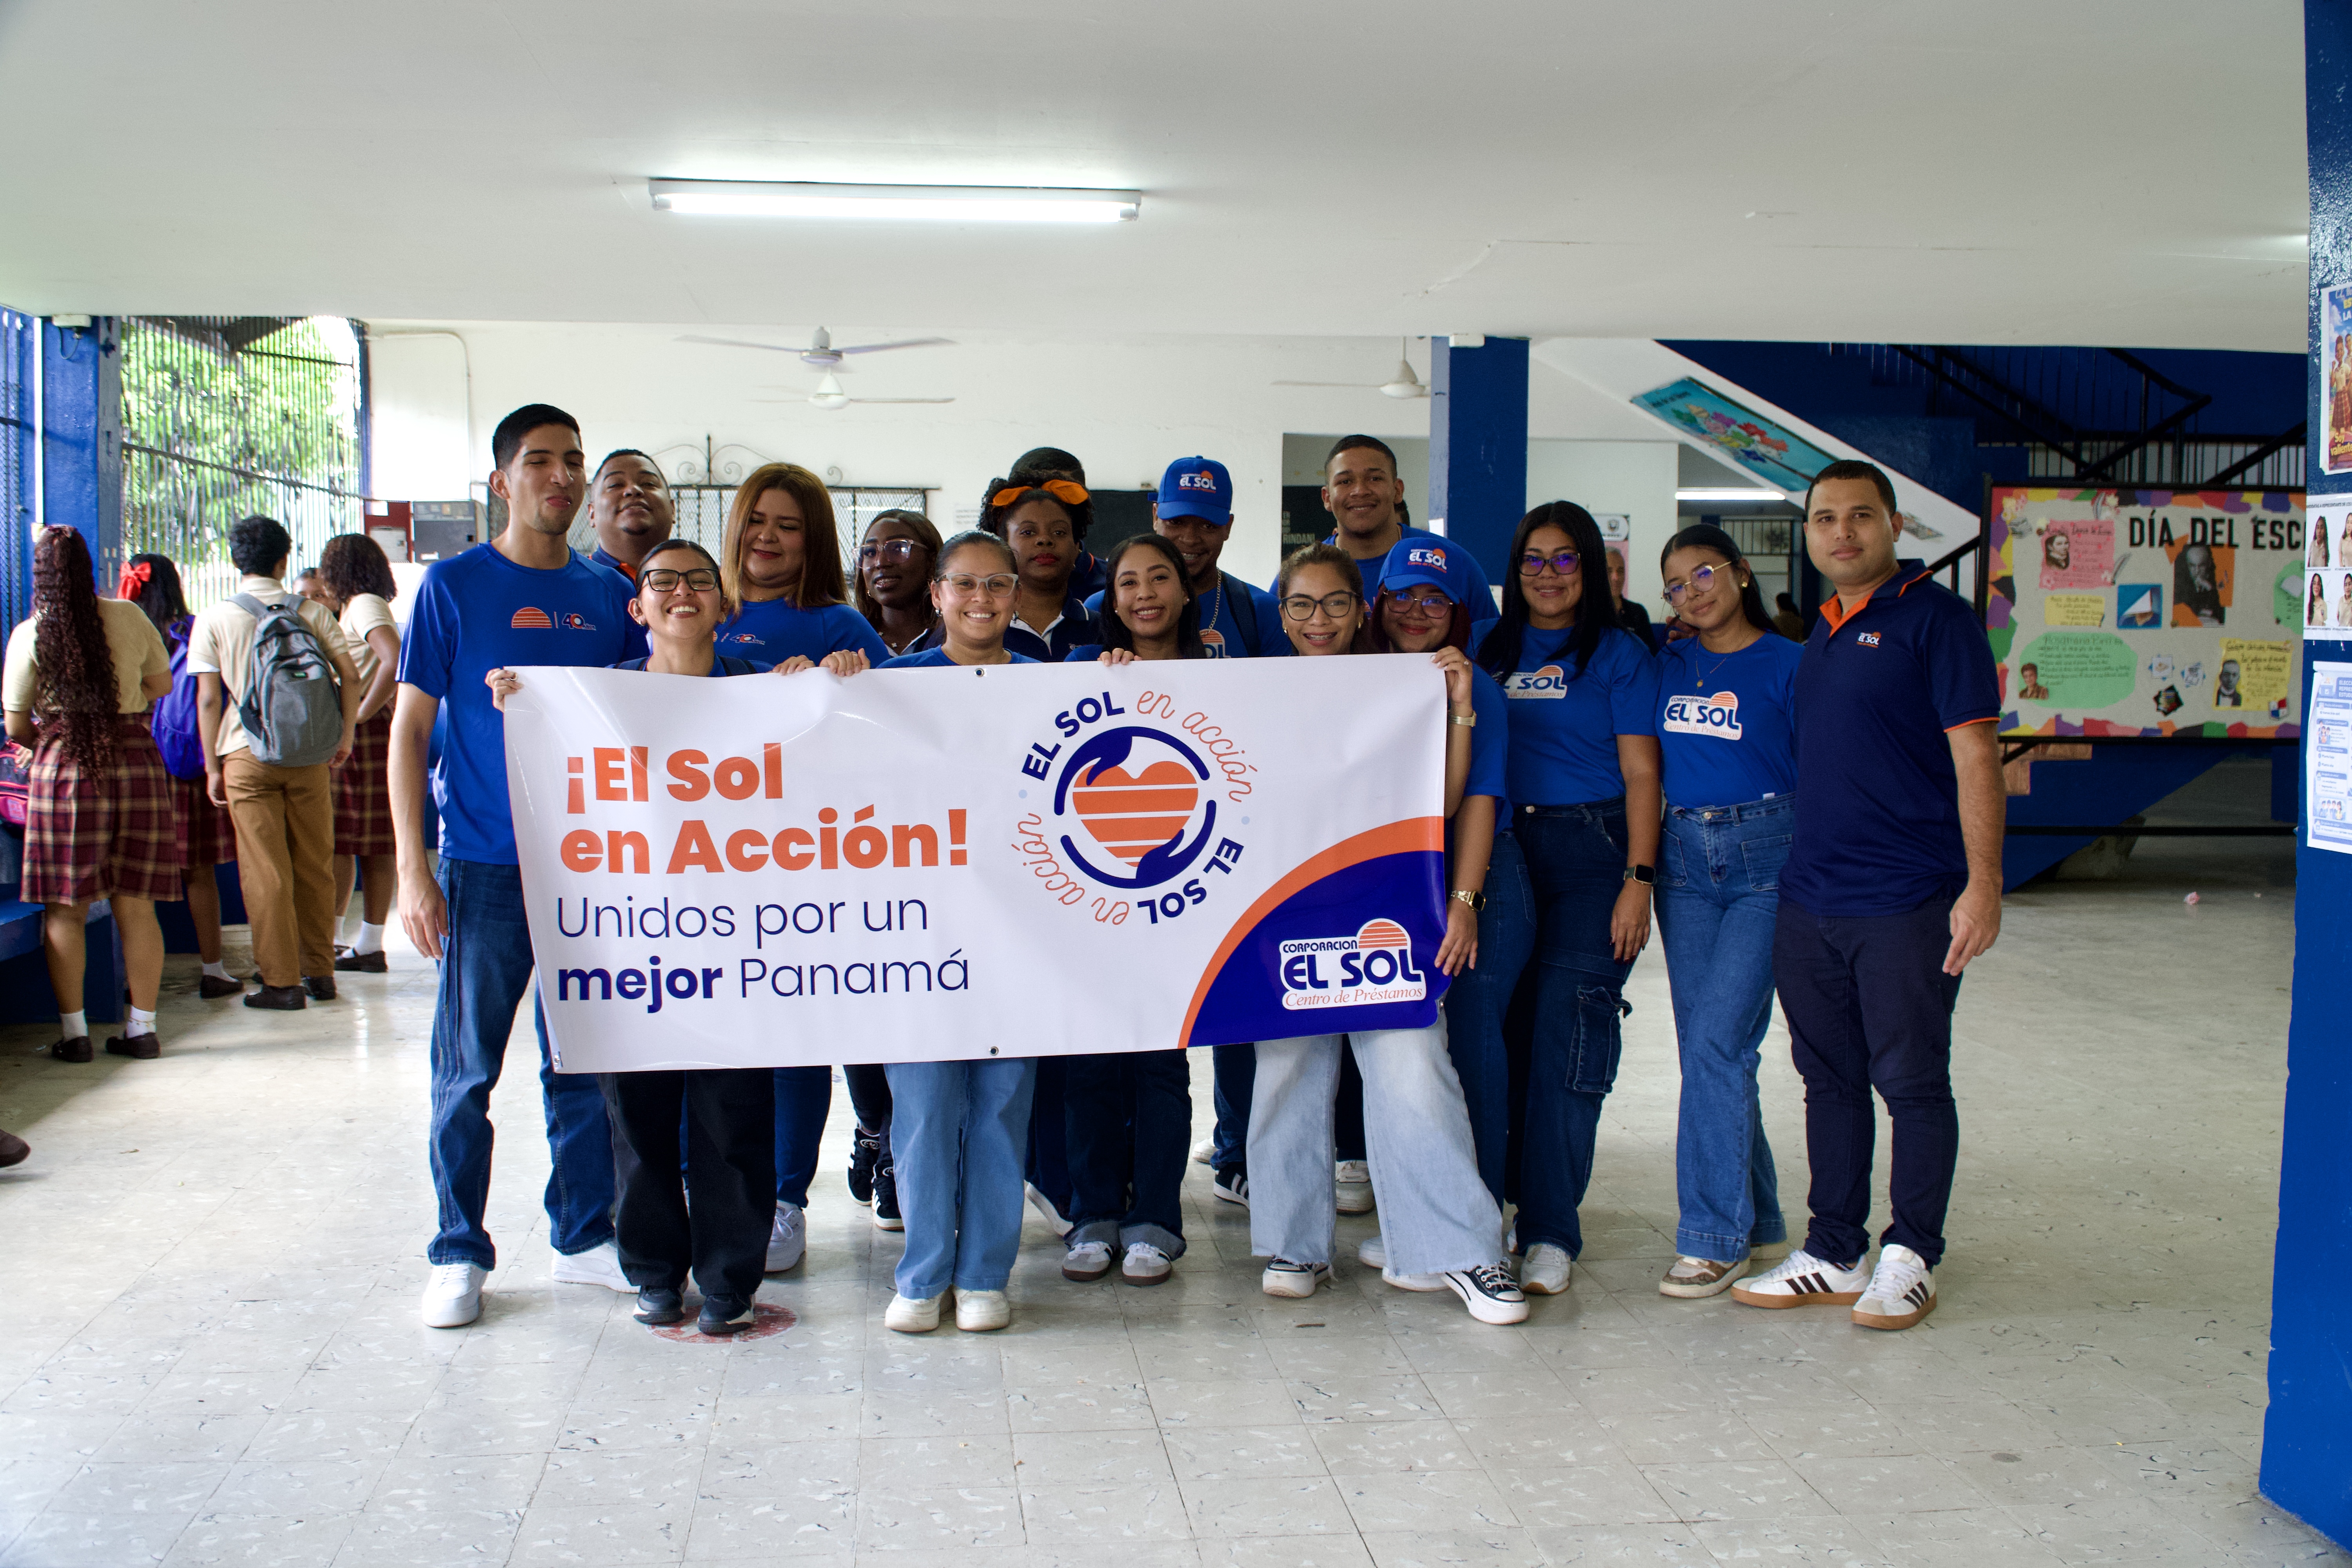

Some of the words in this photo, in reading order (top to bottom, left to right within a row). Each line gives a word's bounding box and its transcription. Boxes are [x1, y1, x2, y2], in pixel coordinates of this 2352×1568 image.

[2334, 432, 2345, 444] Soy
[1180, 477, 1191, 487] EL
[1194, 477, 1216, 490] SOL
[2129, 508, 2174, 548] DÍA
[2190, 517, 2239, 548] DEL
[2252, 518, 2306, 550] ESC
[1409, 552, 1422, 562] EL
[1425, 553, 1447, 570] SOL
[561, 613, 585, 629] 40
[730, 633, 755, 643] 40
[1865, 636, 1880, 646] SOL
[1517, 676, 1565, 690] SOL
[1666, 703, 1689, 722] EL
[1696, 706, 1739, 730] SOL
[1021, 742, 1062, 781] EL
[1055, 691, 1125, 738] SOL
[1137, 691, 1174, 719] en
[1182, 711, 1258, 802] acción
[568, 746, 649, 814] ¡El
[667, 743, 783, 802] Sol
[561, 829, 650, 874] en
[666, 804, 967, 874] Acción!
[1203, 837, 1244, 875] EL
[1092, 897, 1129, 925] en
[1137, 878, 1207, 924] SOL
[558, 896, 735, 938] Unidos
[756, 902, 845, 949] por
[864, 899, 927, 932] un
[1283, 940, 1357, 953] CORPORACION
[558, 956, 722, 1013] mejor
[741, 948, 969, 998] Panamá
[1284, 955, 1328, 990] EL
[1341, 949, 1422, 987] SOL
[1286, 993, 1330, 1006] Centro
[1334, 990, 1350, 1004] de
[1354, 988, 1423, 1002] Préstamos
